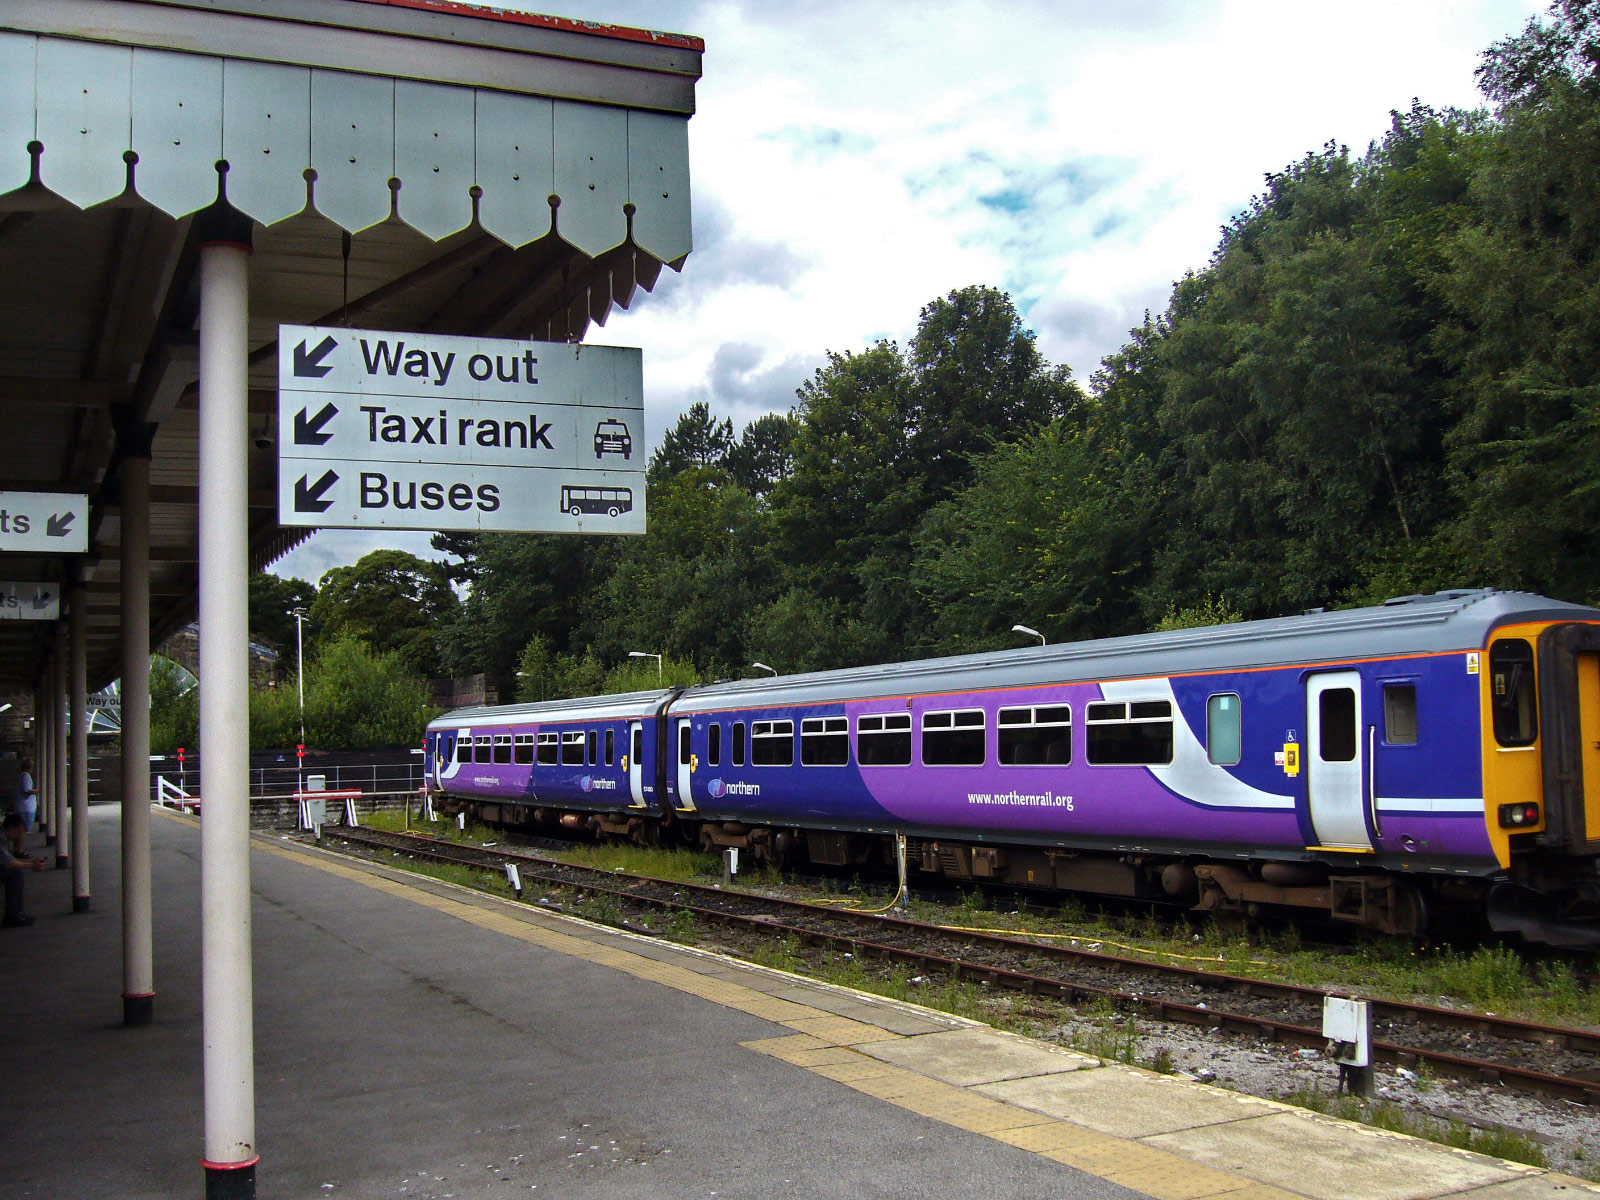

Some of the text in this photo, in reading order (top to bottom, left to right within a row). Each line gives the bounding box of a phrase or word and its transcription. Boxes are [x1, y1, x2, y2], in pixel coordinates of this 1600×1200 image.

[359, 339, 539, 386] Way out
[359, 406, 555, 450] Taxi rank
[359, 471, 501, 512] Buses
[85, 697, 107, 707] Way
[726, 780, 760, 796] northern
[967, 790, 1074, 811] www.northernrail.org
